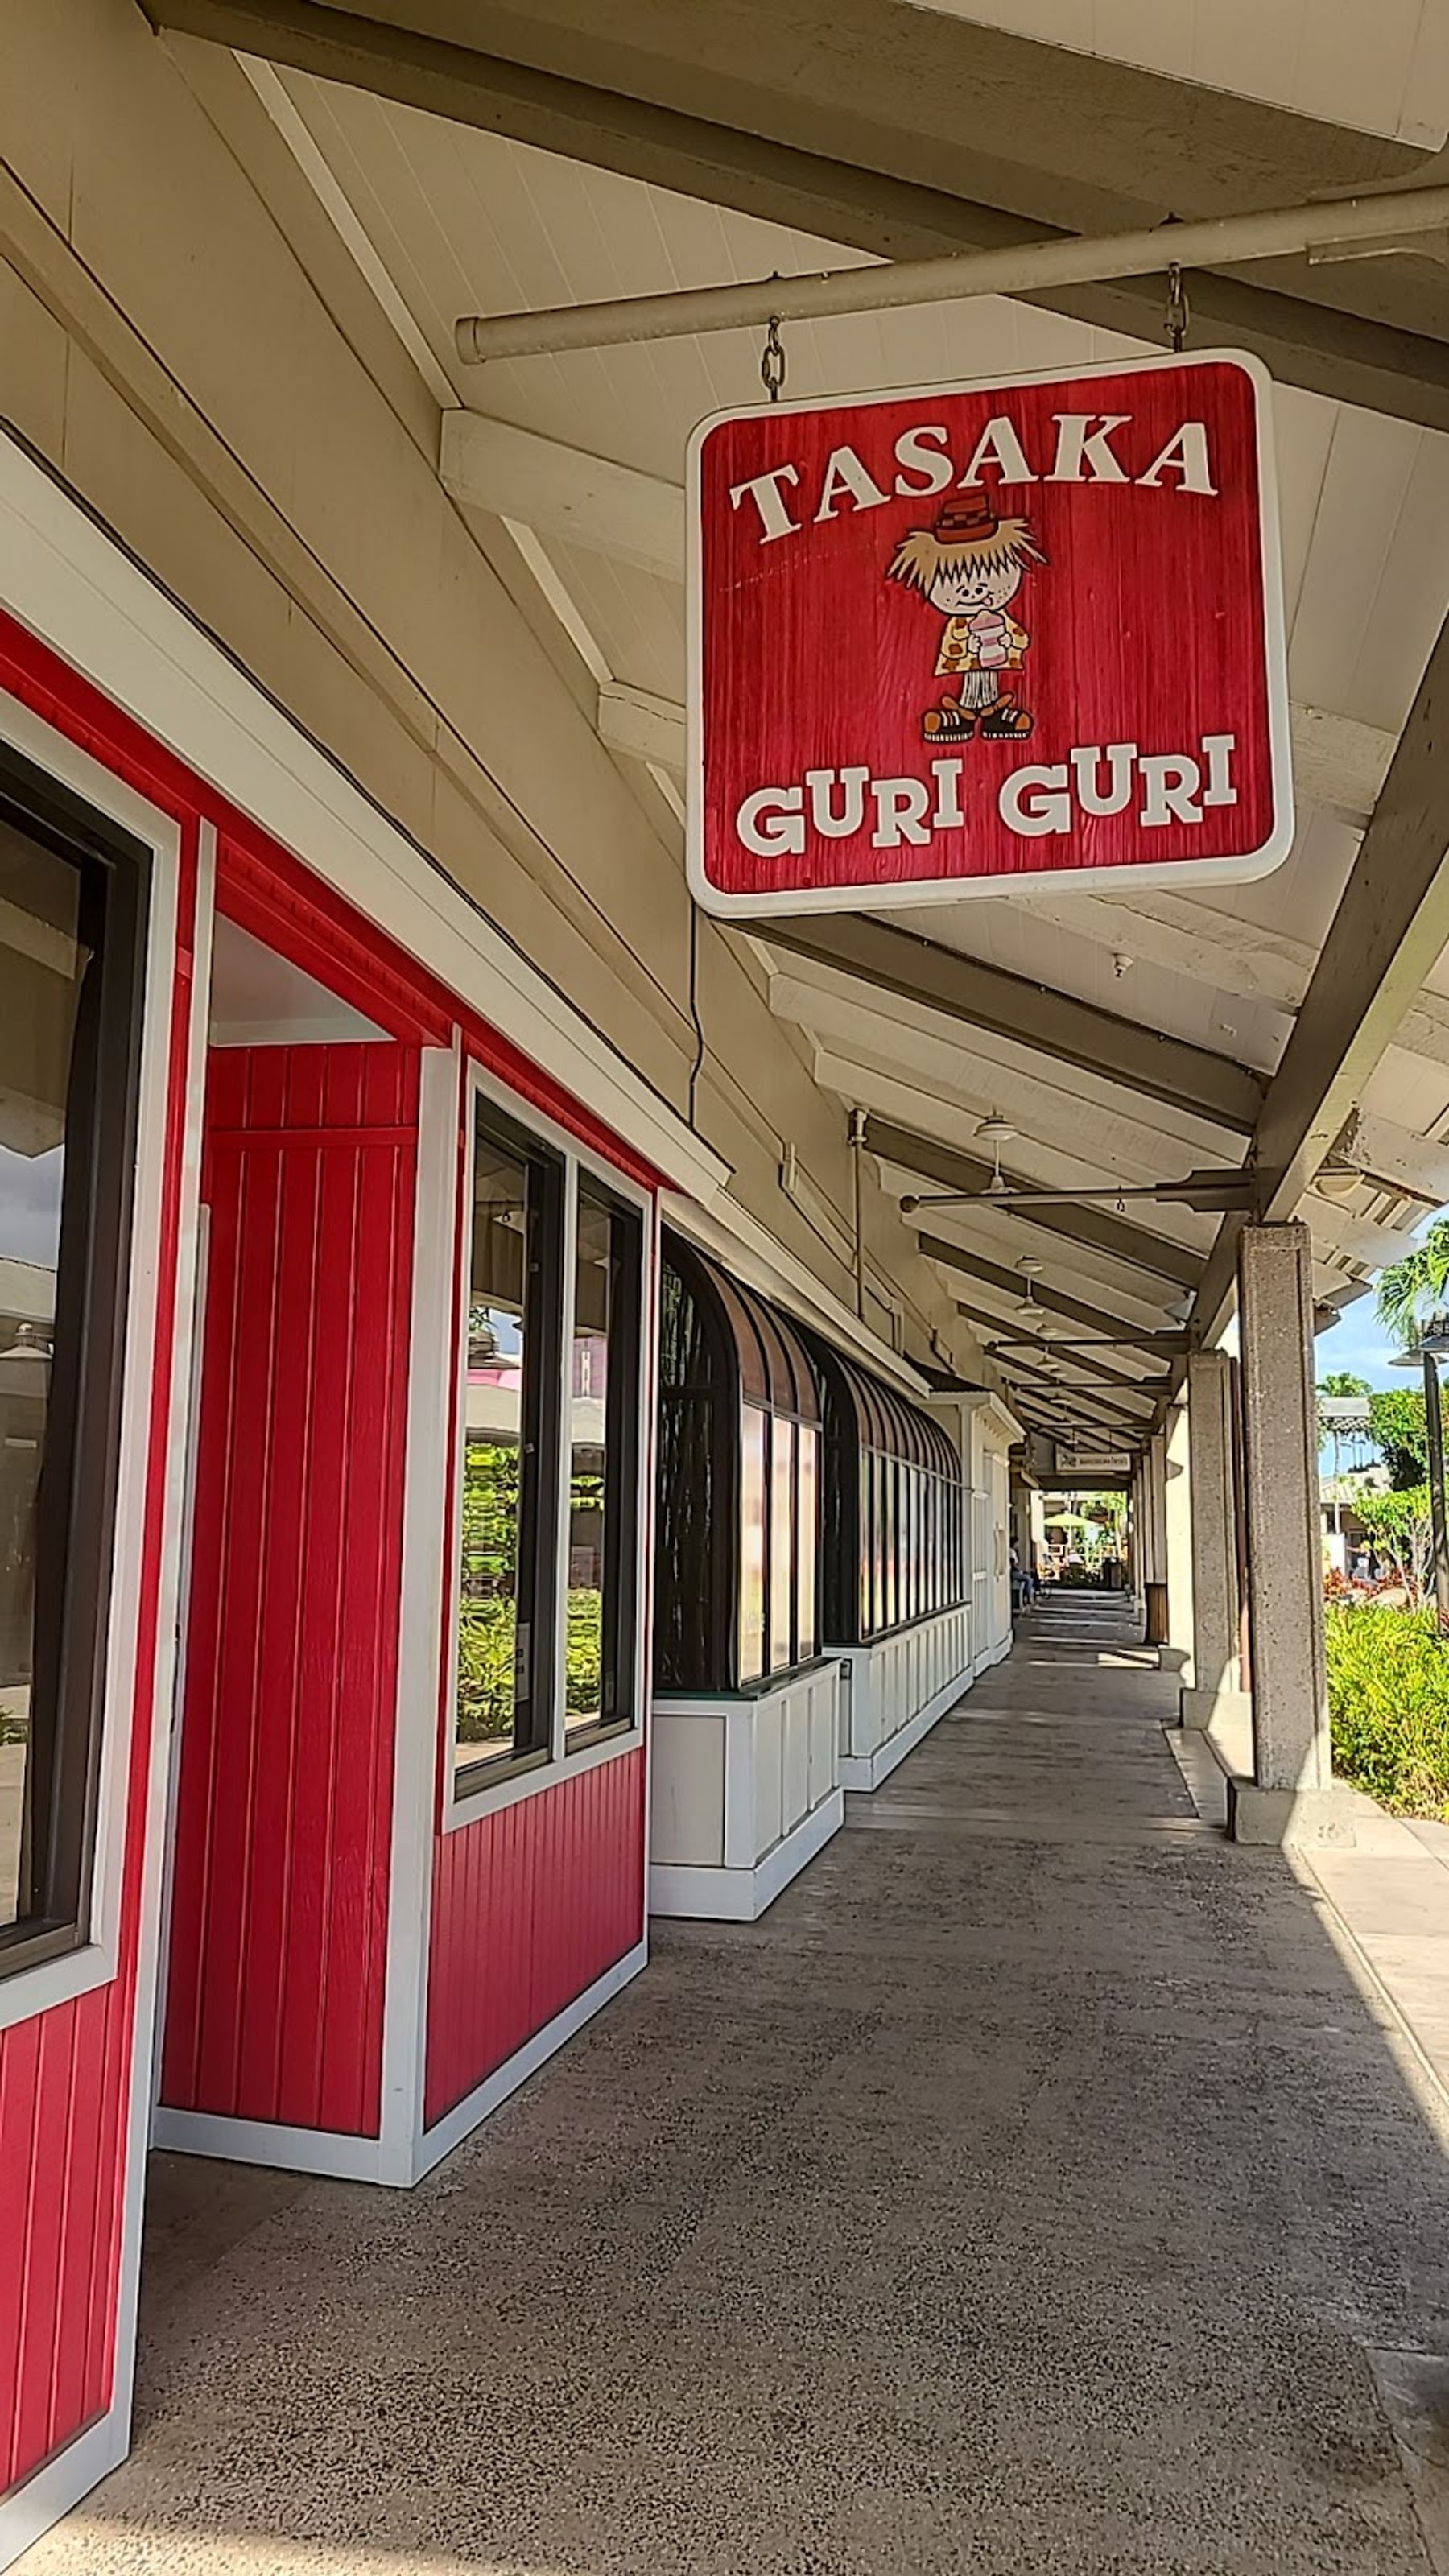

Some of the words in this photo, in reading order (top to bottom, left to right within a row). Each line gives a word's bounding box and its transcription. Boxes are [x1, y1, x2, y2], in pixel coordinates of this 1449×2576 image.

[729, 414, 1219, 543] TASAKA
[736, 758, 964, 857] GURI
[998, 734, 1237, 837] GURI
